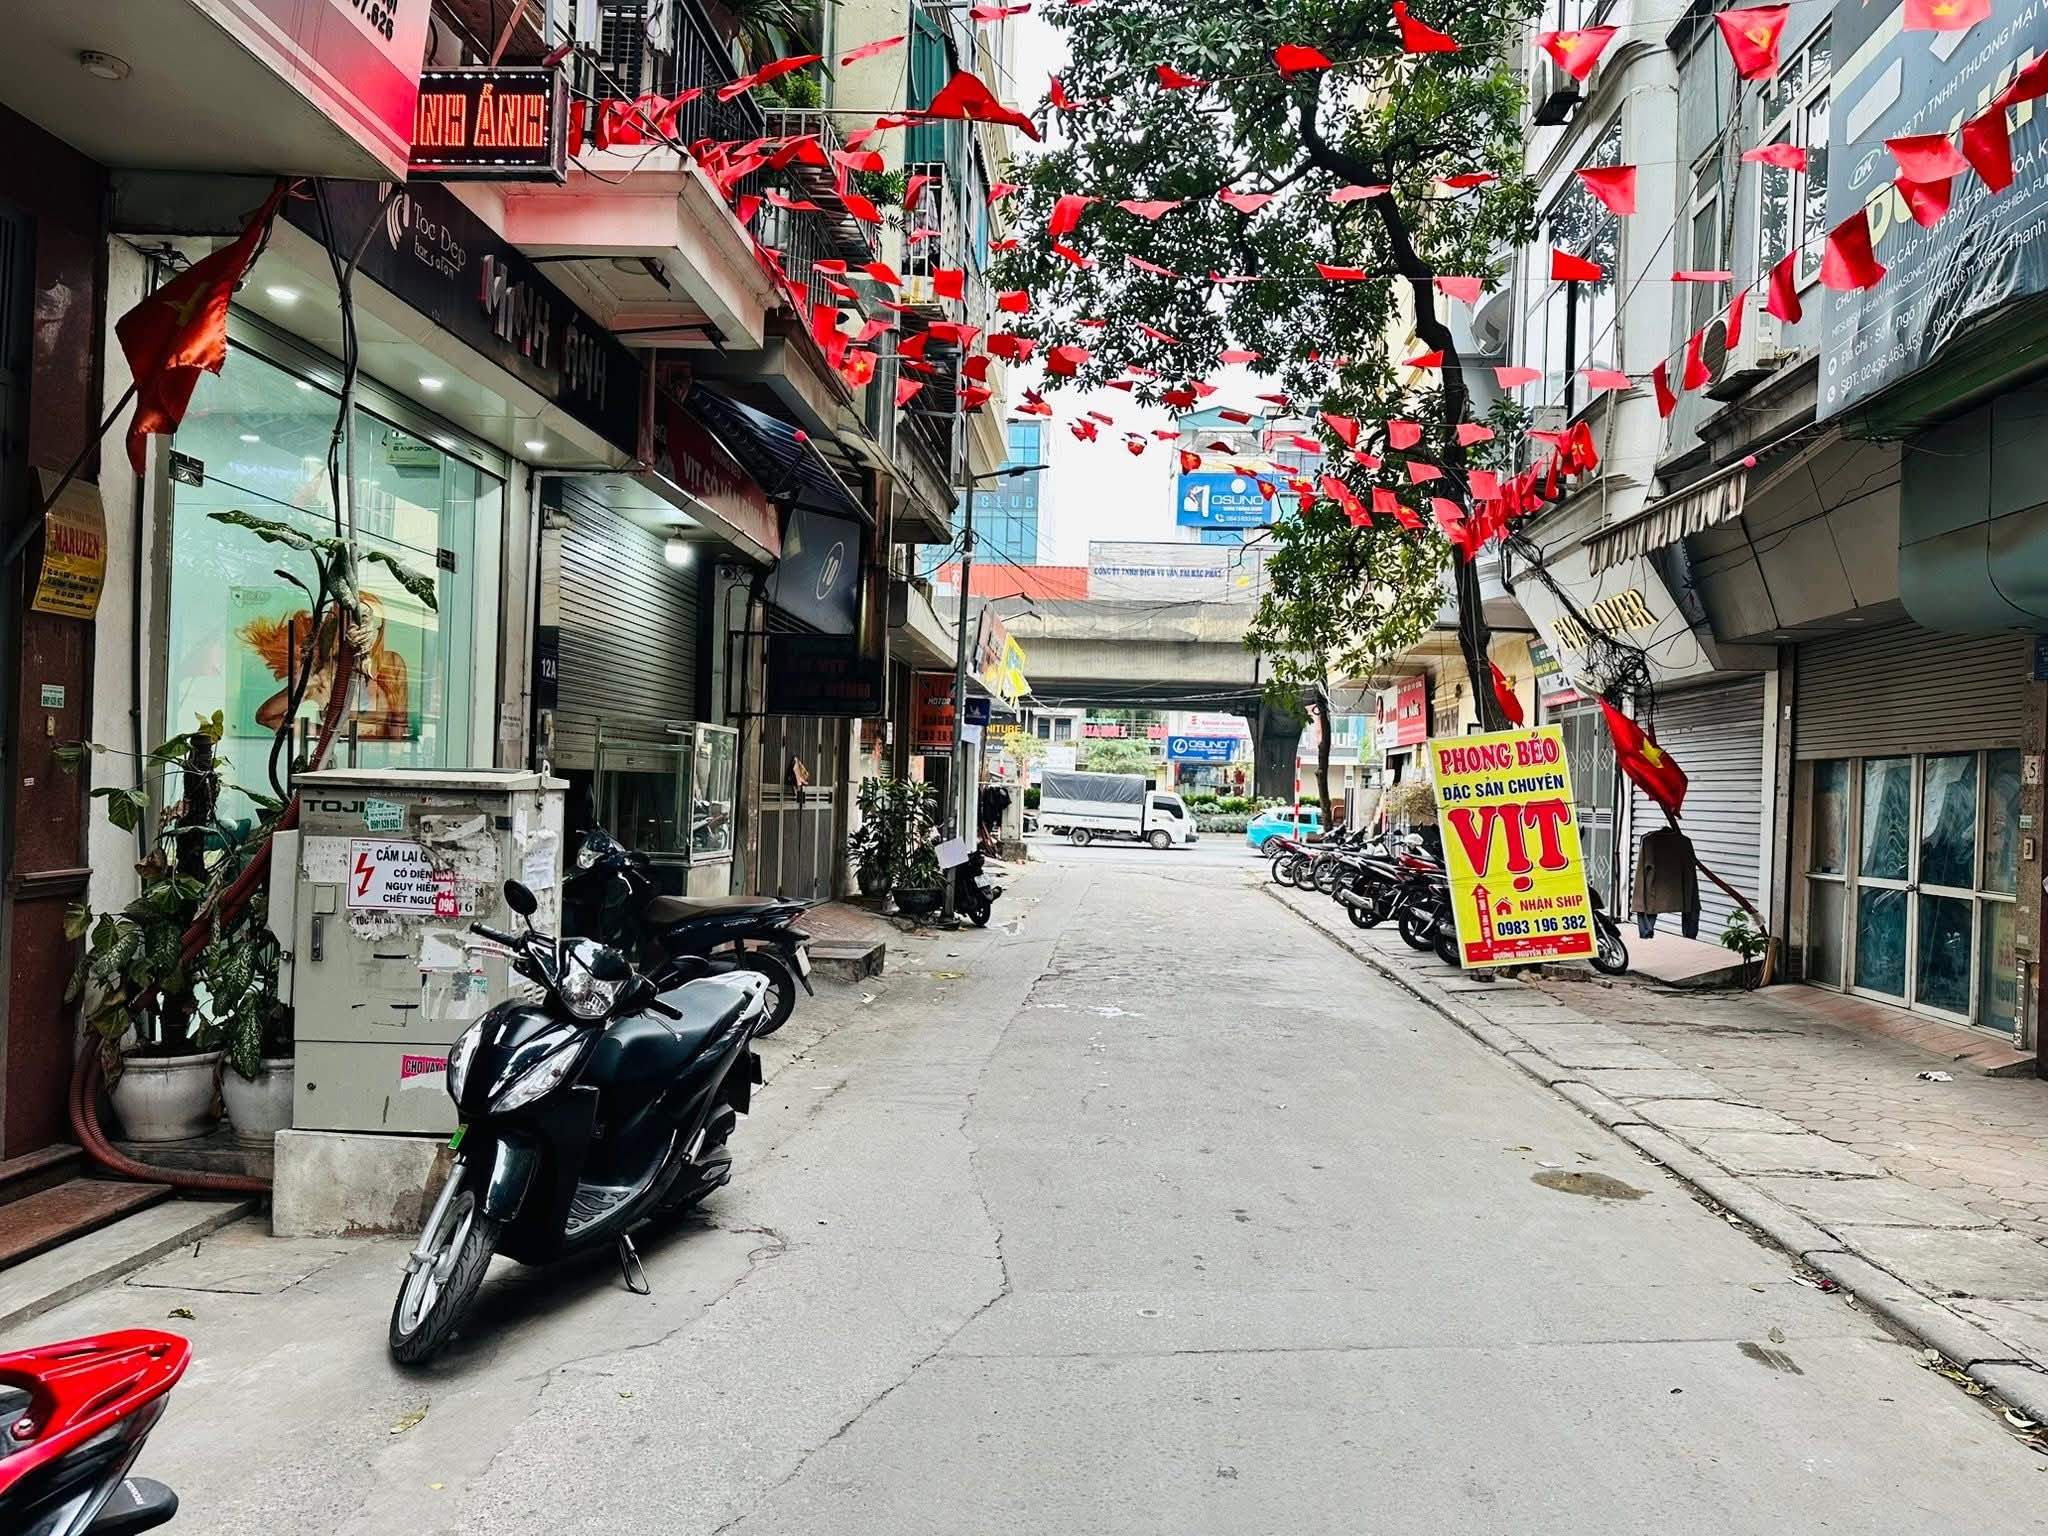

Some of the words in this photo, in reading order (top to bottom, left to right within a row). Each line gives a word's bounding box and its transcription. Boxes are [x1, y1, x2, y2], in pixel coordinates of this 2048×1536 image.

[541, 657, 557, 680] 12A
[1438, 743, 1513, 776] PHONG
[1514, 731, 1559, 767] BÉO
[1443, 783, 1471, 803] ĐẶC
[1475, 776, 1505, 797] SẢN
[1508, 773, 1564, 794] CHUYÊN
[376, 845, 399, 862] CẤM
[402, 850, 417, 866] LẠI
[1447, 798, 1571, 892] VỊT
[394, 868, 407, 878] CÓ
[410, 868, 433, 882] ĐIỆN
[386, 882, 413, 892] NGUY
[416, 880, 439, 893] HIỂM
[383, 892, 408, 903] CHẾT
[1520, 895, 1553, 913] NHẬN
[1557, 894, 1583, 908] SHIP
[1497, 921, 1530, 936] 0983
[1534, 917, 1558, 933] 196
[1562, 915, 1587, 930] 382
